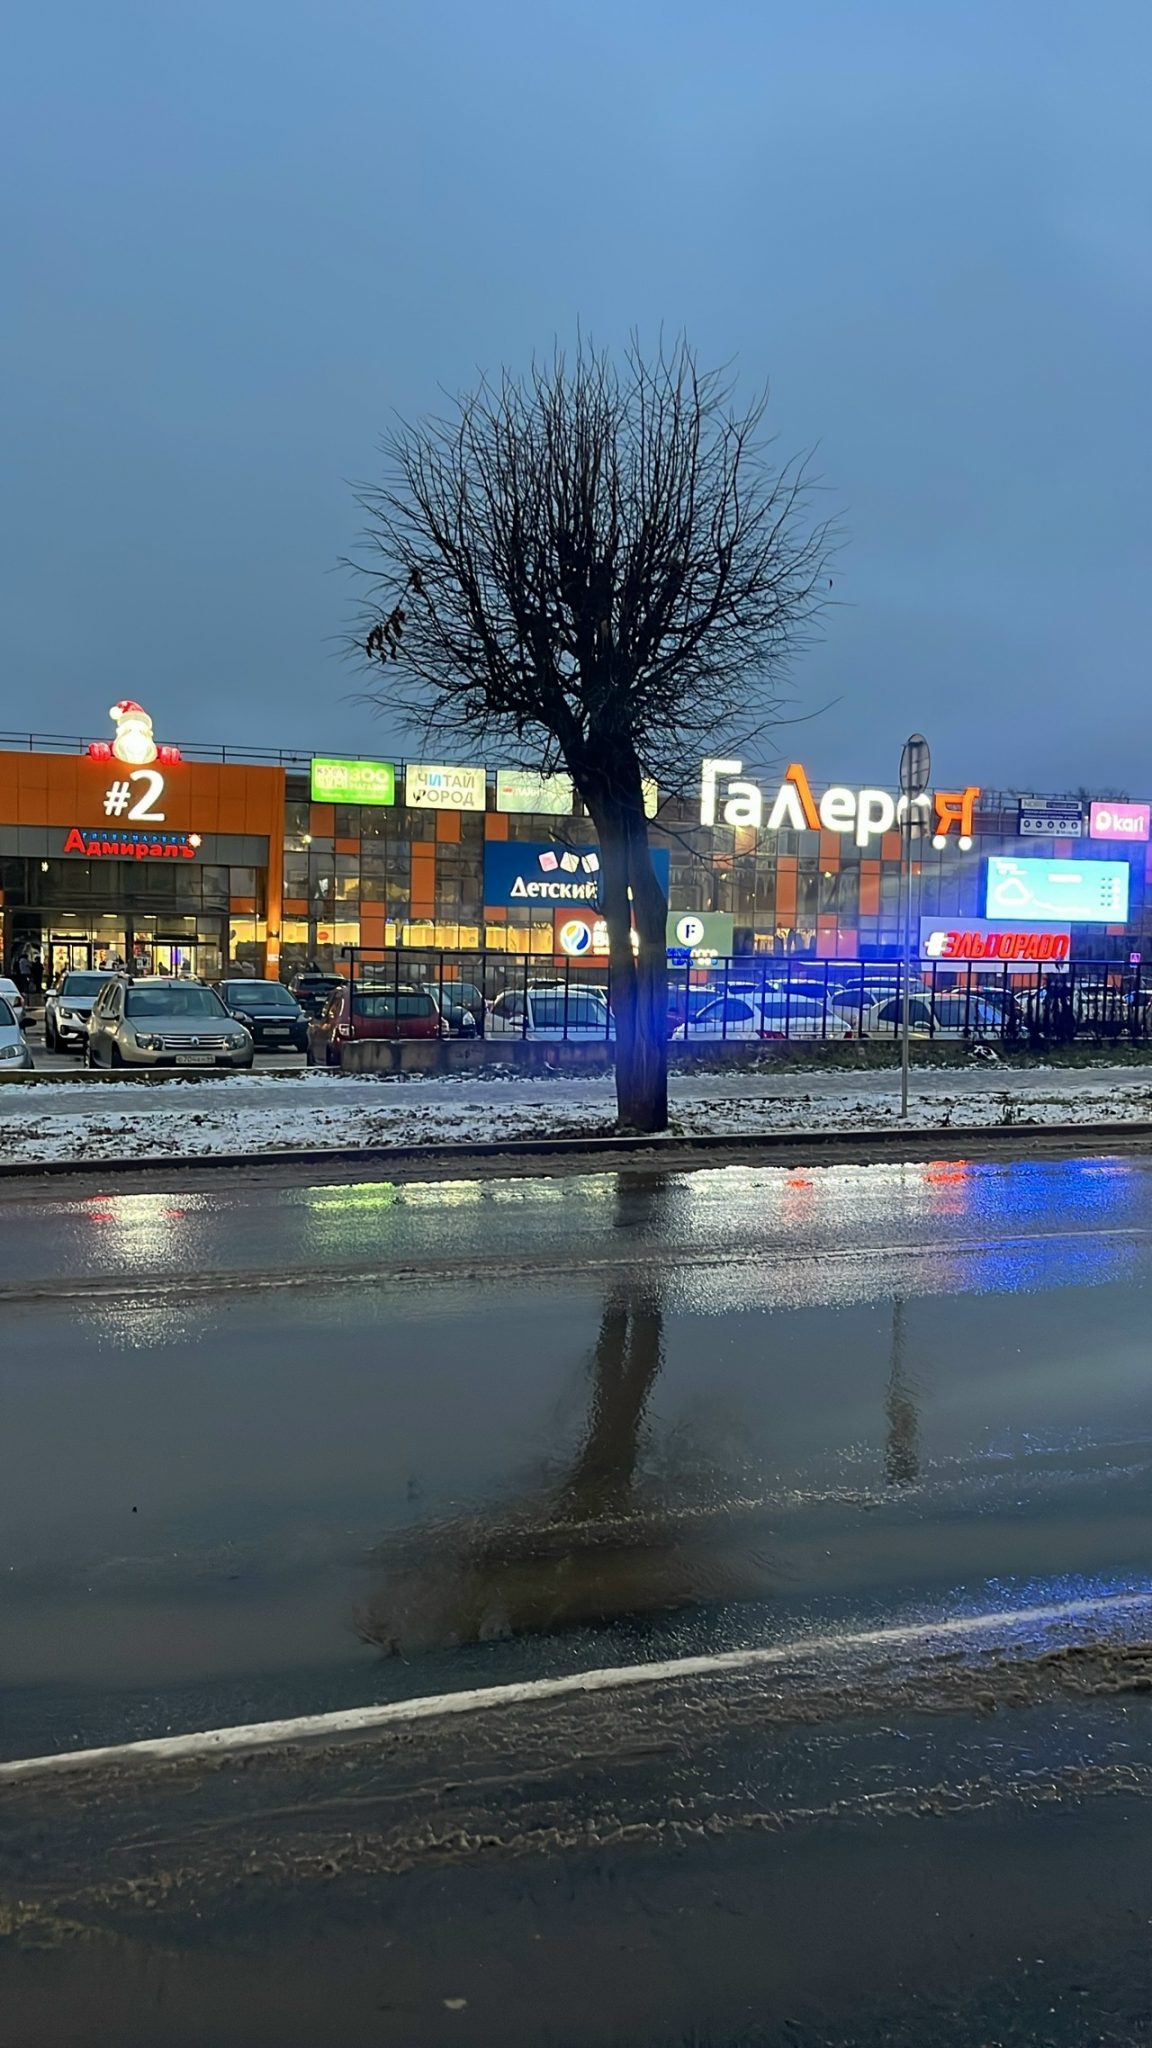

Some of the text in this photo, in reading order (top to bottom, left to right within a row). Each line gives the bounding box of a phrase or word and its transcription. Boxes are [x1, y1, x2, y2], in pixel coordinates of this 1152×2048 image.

[418, 771, 475, 788] ЧИТАЙ
[103, 768, 166, 822] #2
[1113, 814, 1145, 833] kari
[63, 828, 196, 859] Адмиралъ
[510, 876, 598, 900] Детский
